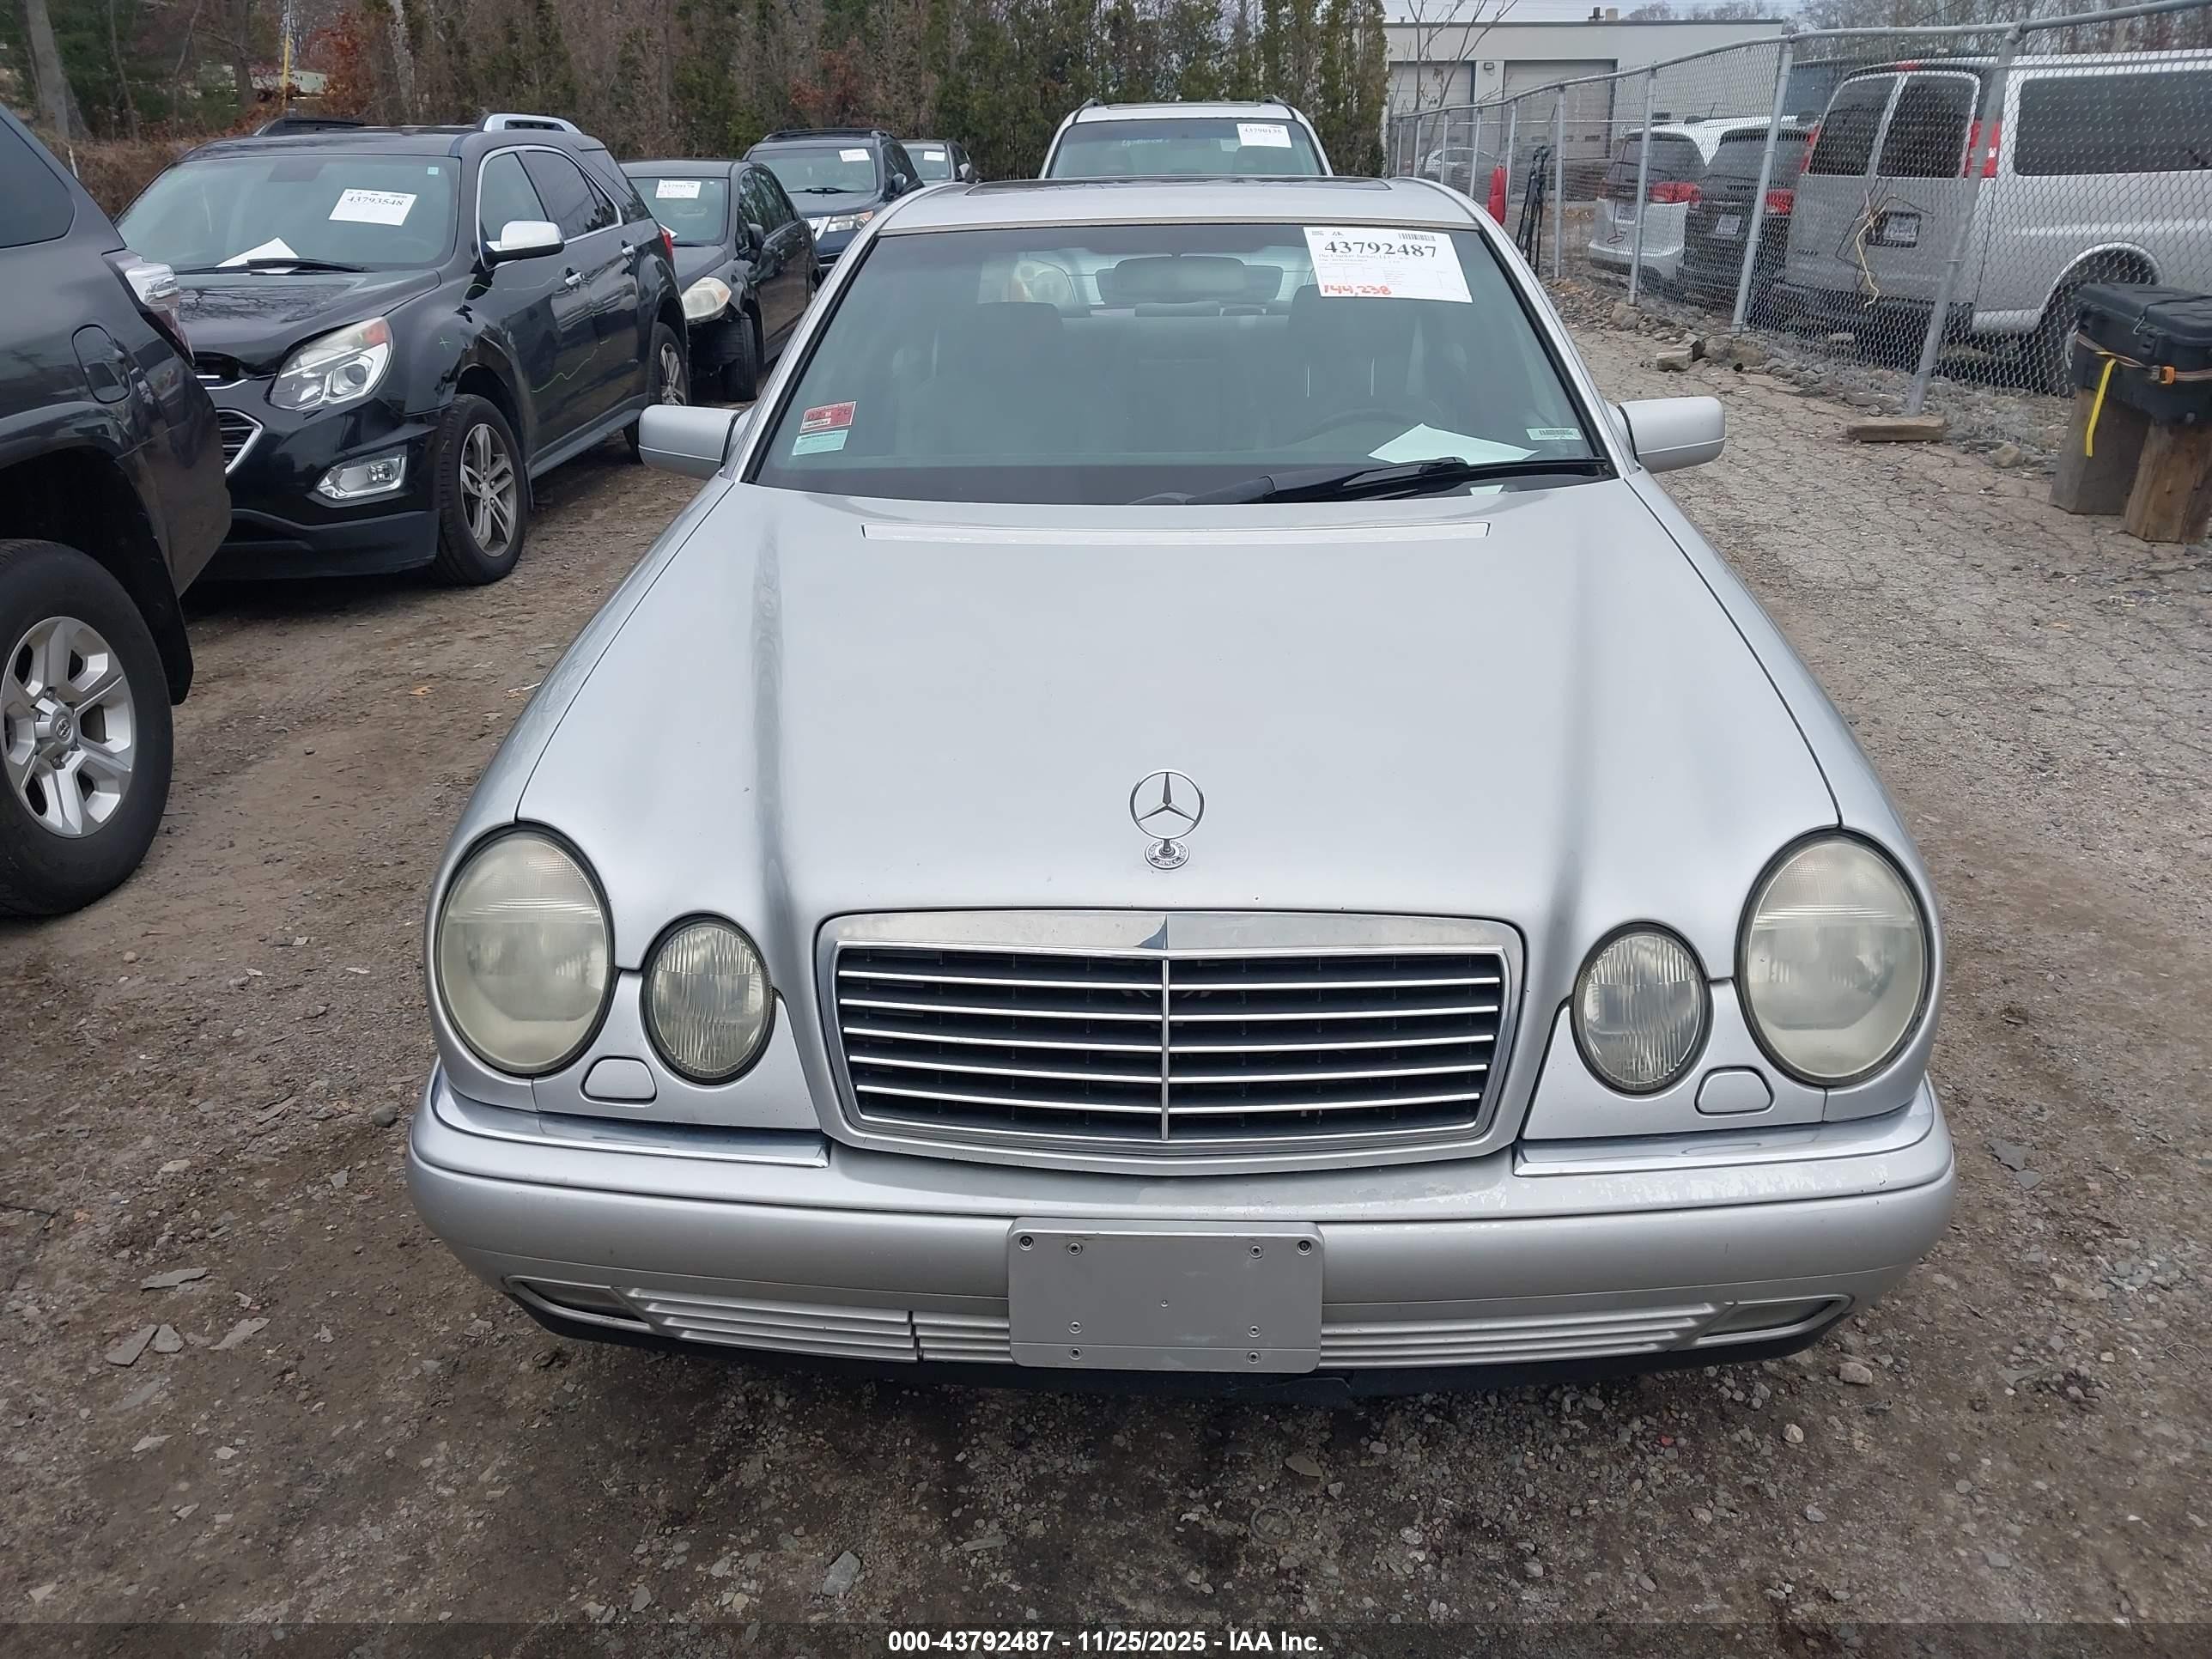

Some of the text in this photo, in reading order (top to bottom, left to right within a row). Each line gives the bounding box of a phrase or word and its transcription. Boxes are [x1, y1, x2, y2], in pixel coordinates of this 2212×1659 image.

[347, 196, 404, 206] 43793548
[1324, 241, 1437, 258] 43792487
[1324, 284, 1392, 296] 144,238
